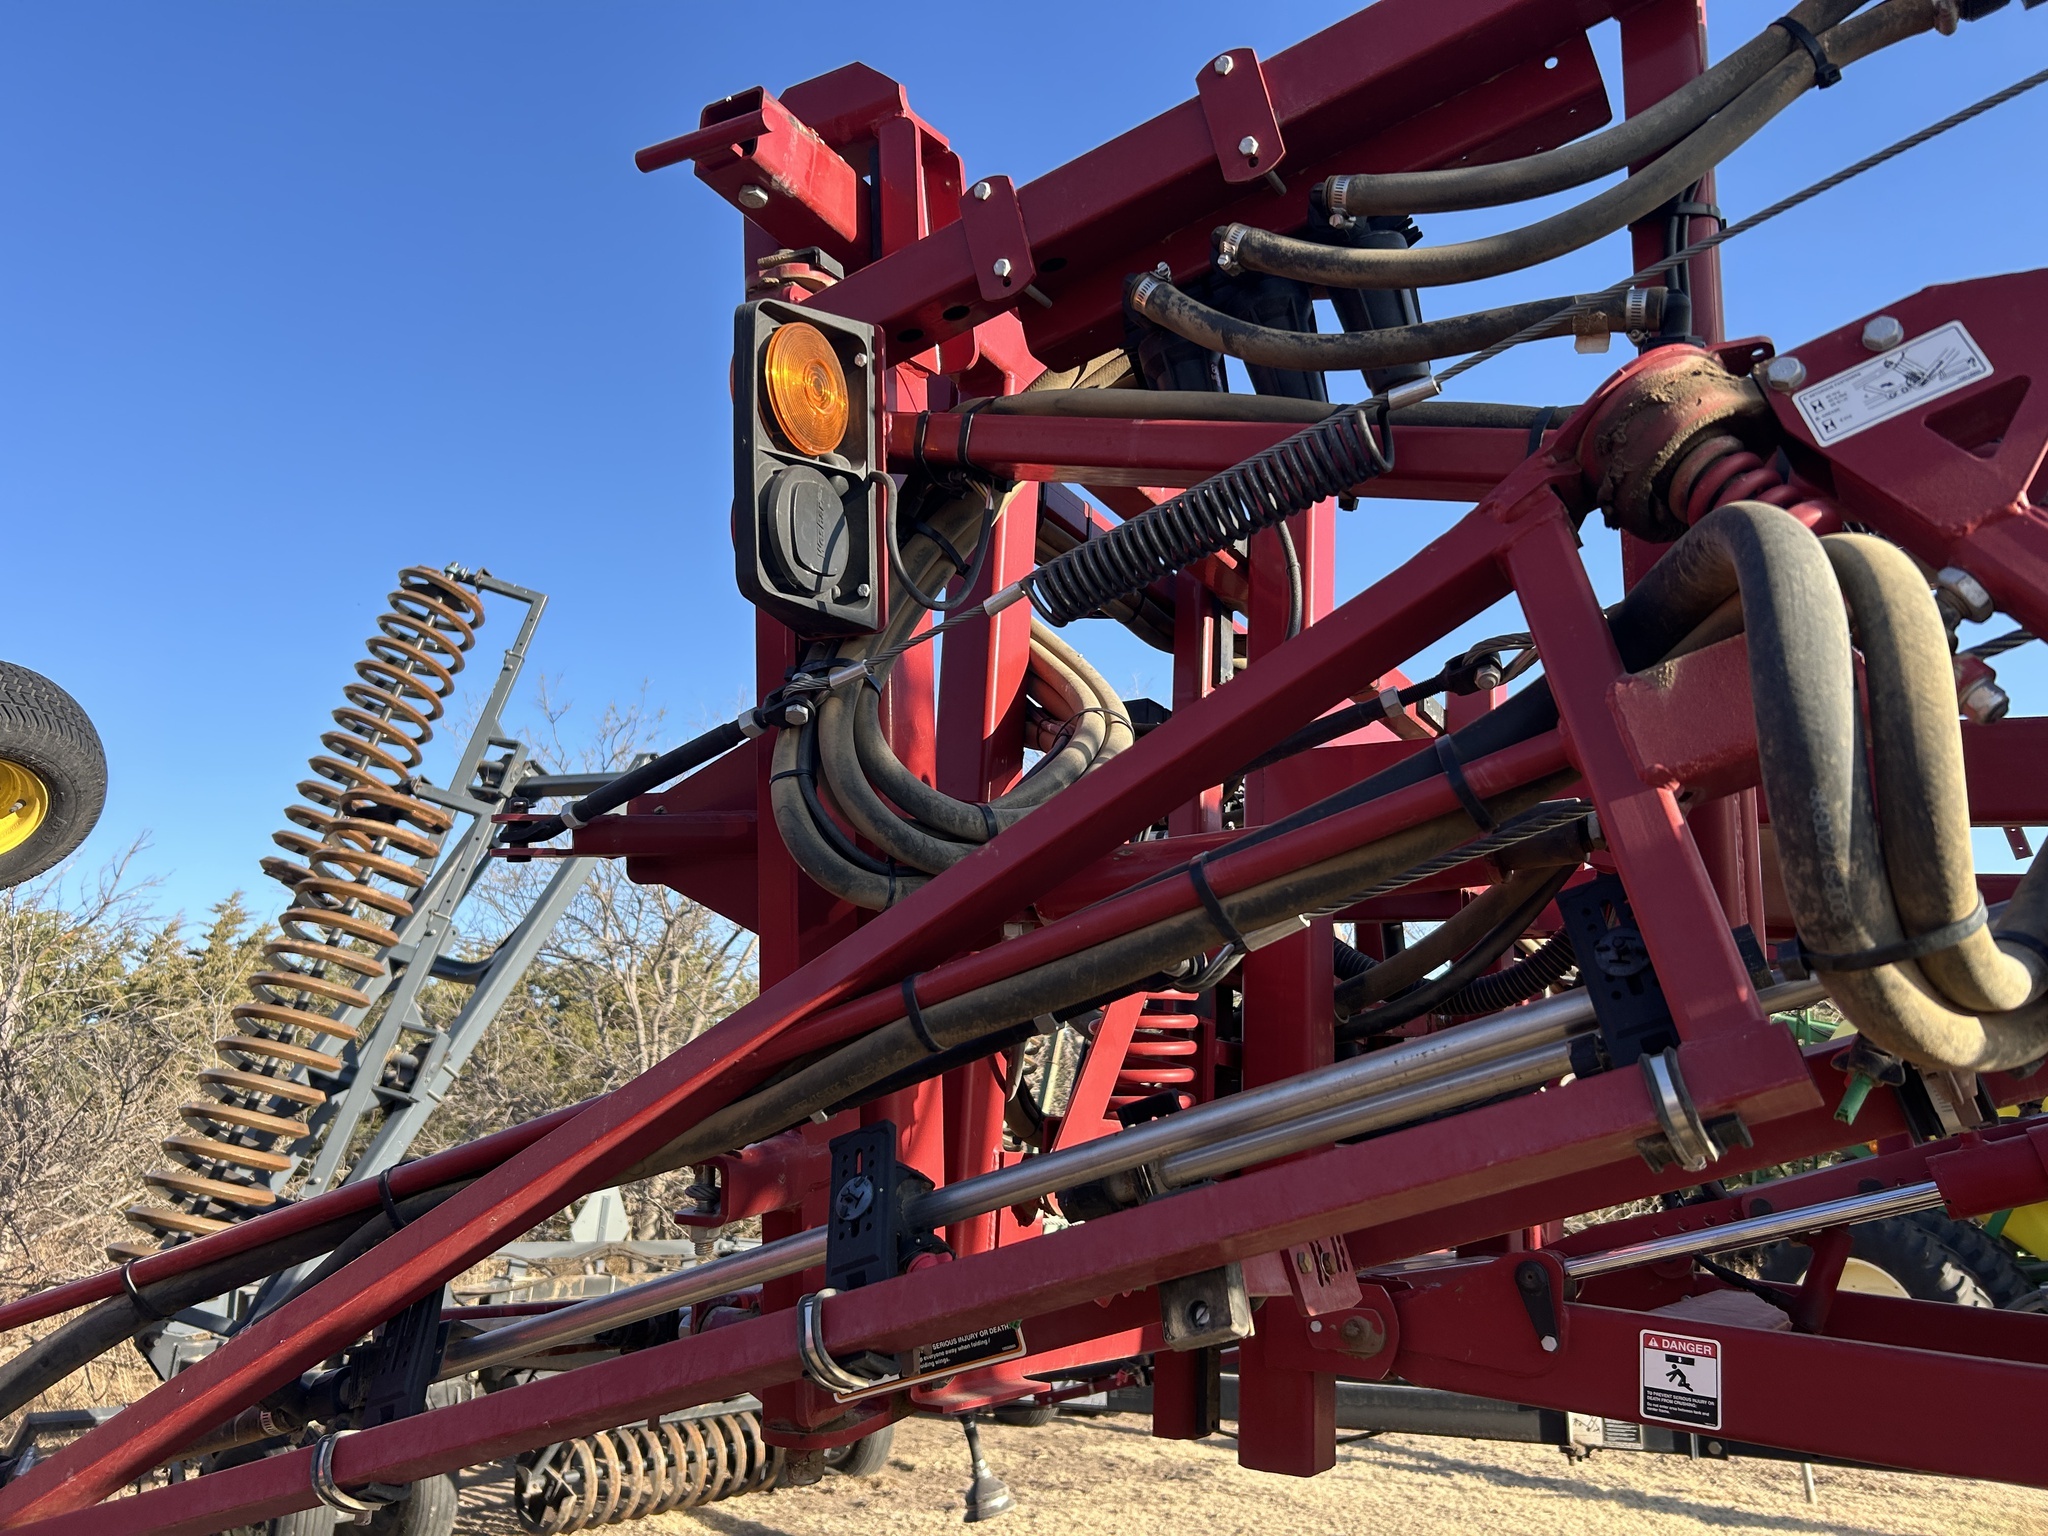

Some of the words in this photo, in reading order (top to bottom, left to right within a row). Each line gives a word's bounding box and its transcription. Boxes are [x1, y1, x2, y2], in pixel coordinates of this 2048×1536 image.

[933, 1338, 957, 1350] SERIOUS
[958, 1332, 978, 1344] INJURY
[979, 1329, 989, 1338] OR
[958, 1344, 970, 1352] when
[1662, 1338, 1712, 1355] DANGER
[1692, 1397, 1707, 1405] INJURY
